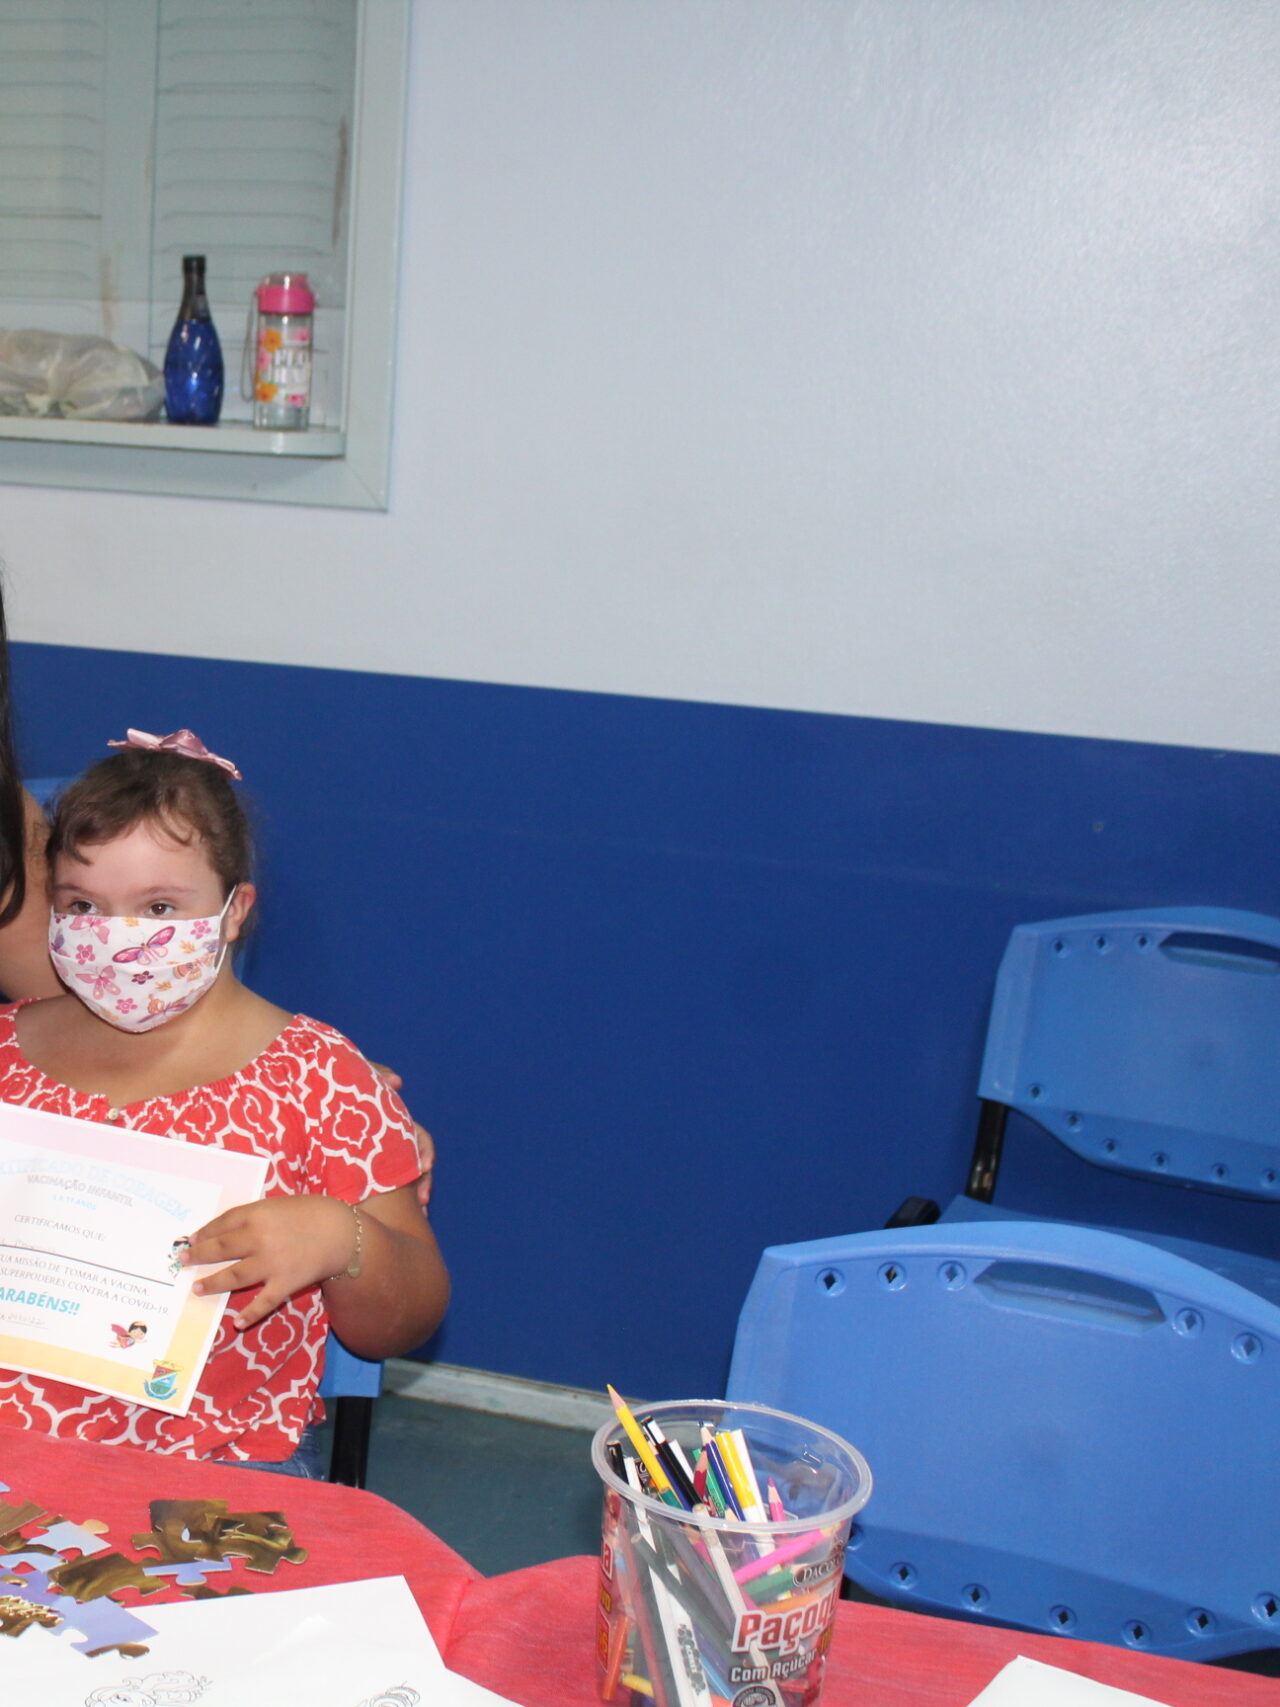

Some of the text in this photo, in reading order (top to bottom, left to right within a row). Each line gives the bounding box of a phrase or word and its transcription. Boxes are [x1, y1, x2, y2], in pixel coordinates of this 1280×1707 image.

[26, 1174, 86, 1193] VACINAÇÃO
[14, 1214, 81, 1234] CERTIFICAMOS
[14, 1255, 48, 1269] MISSÃO
[48, 1262, 61, 1273] DE
[63, 1265, 98, 1283] TOMAR
[99, 1274, 108, 1284] A
[67, 1280, 110, 1299] CONTRA
[730, 1666, 767, 1682] Com
